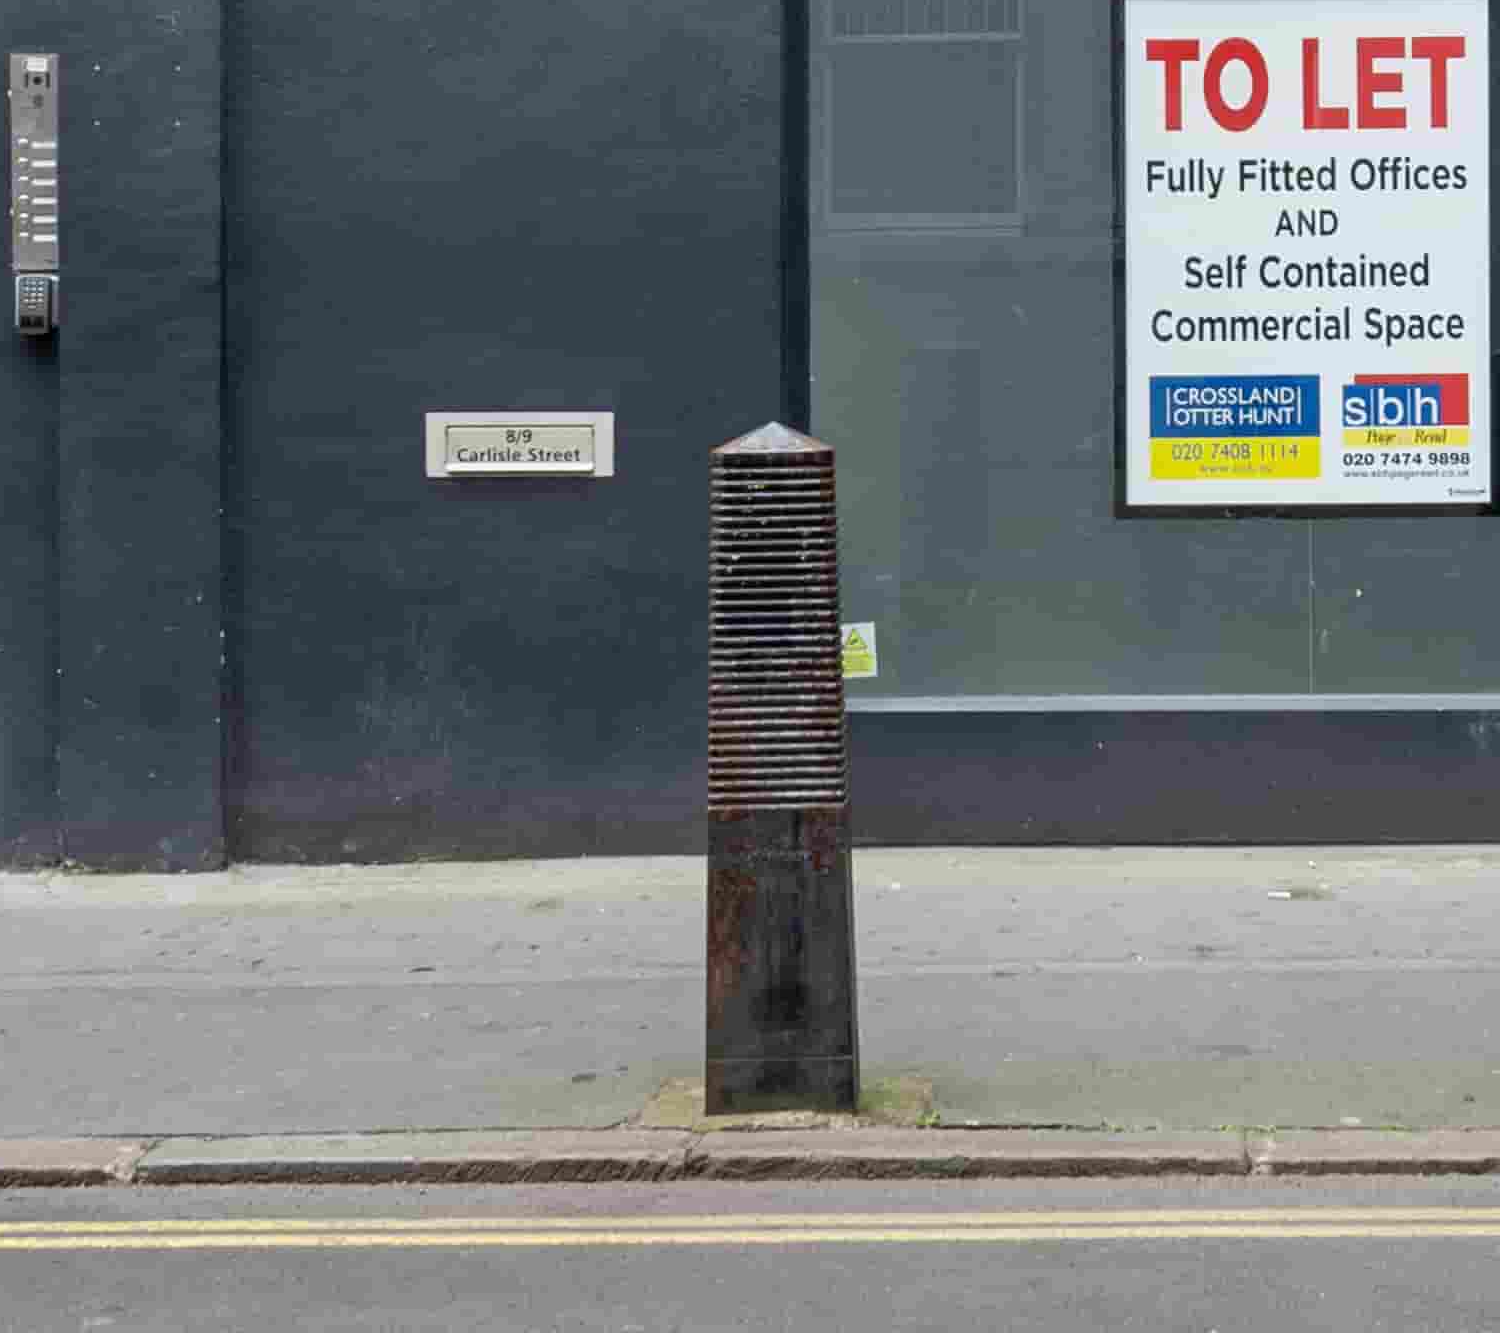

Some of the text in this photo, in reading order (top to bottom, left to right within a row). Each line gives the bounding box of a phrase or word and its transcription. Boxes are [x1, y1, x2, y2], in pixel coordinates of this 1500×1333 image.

[1145, 36, 1466, 133] TO LET
[1146, 157, 1468, 200] Fully Fitted Offices
[1274, 209, 1339, 237] AND
[1183, 253, 1430, 290] Self Contained
[1150, 306, 1465, 347] Commercial Space
[1172, 386, 1296, 407] CROSSLAND
[1173, 407, 1296, 426] OTTER HUNT
[504, 428, 533, 446] 8/9
[456, 446, 581, 462] Carlisle Street
[1342, 452, 1375, 466] 020
[1380, 452, 1423, 466] 7474
